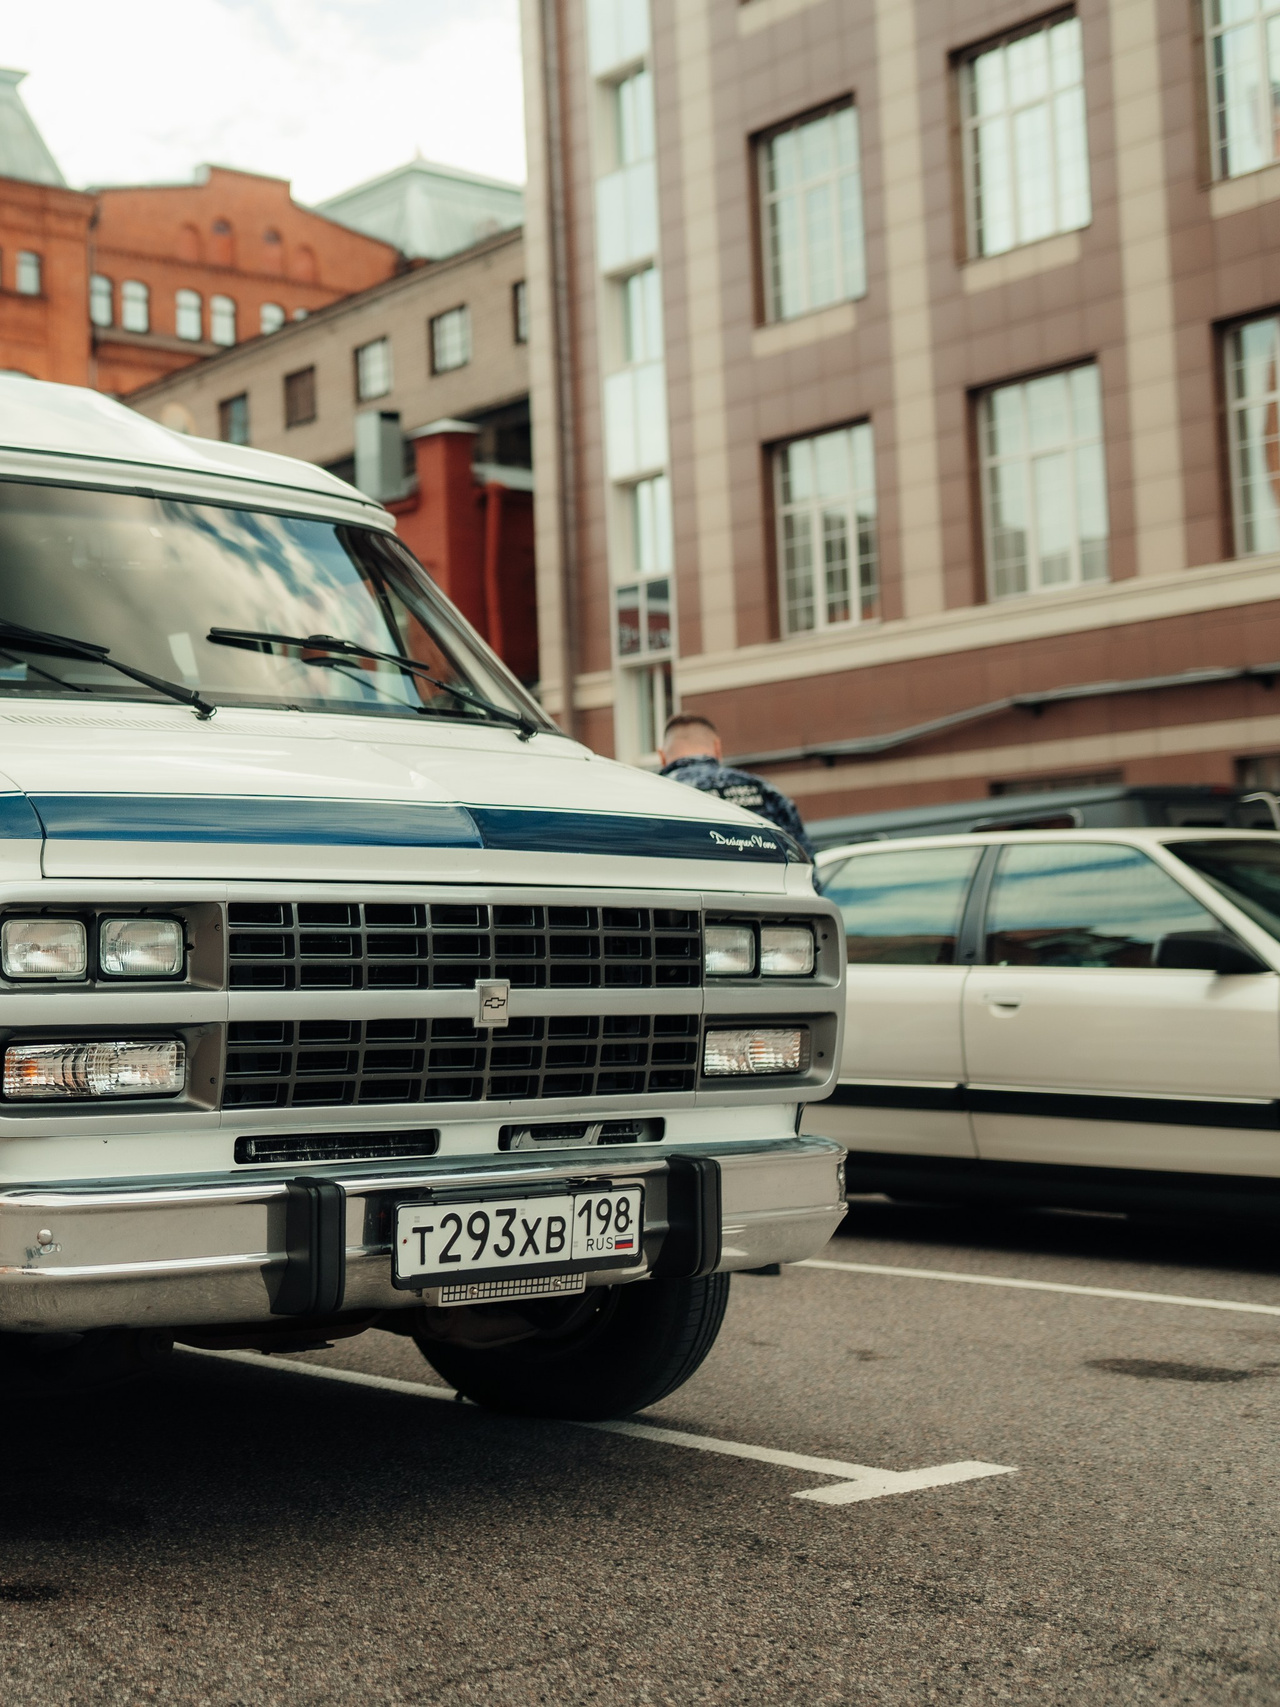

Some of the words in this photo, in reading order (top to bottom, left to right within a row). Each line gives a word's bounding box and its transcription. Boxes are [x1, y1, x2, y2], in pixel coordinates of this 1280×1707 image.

[709, 830, 754, 851] Designer
[577, 1196, 631, 1237] 198
[586, 1236, 614, 1252] RUS
